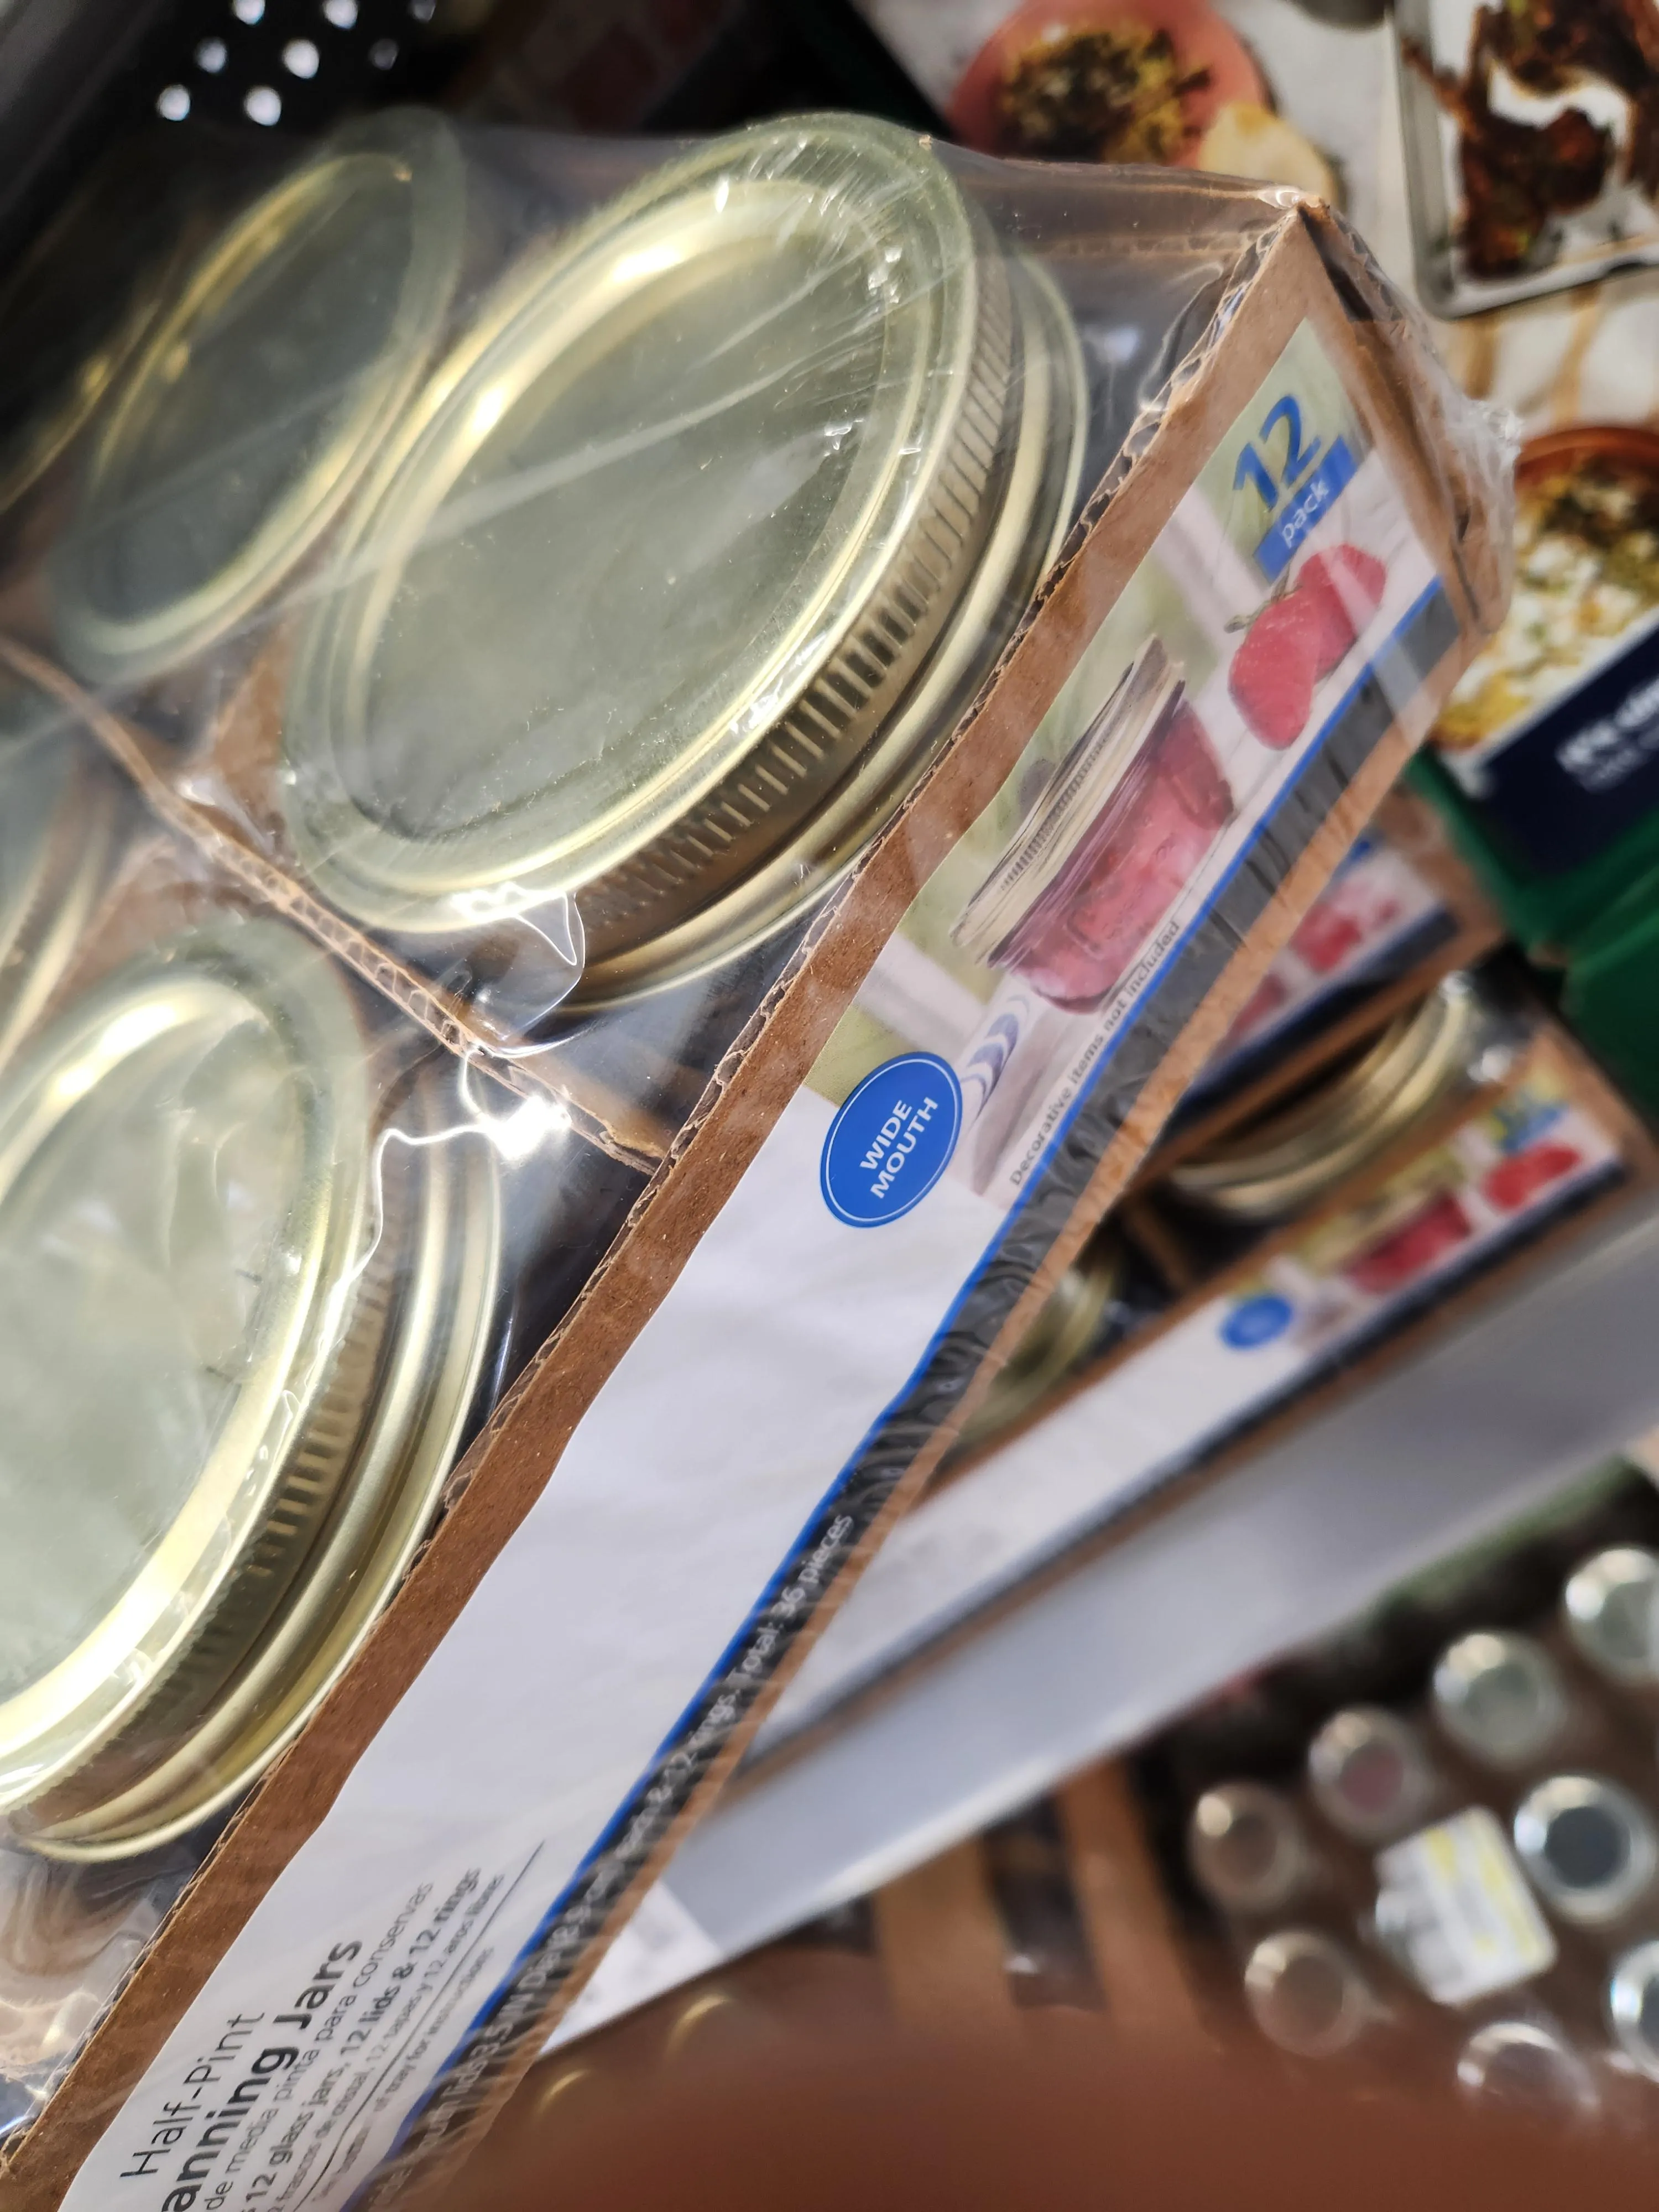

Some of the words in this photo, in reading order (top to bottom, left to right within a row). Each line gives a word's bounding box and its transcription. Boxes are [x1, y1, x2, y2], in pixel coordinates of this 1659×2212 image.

[1233, 394, 1321, 513] 12
[1281, 479, 1329, 549] pack
[1009, 1088, 1072, 1186] Decorative
[1068, 1035, 1105, 1085] items
[1104, 1001, 1126, 1032] not
[1123, 920, 1181, 997] included
[859, 1099, 912, 1170] WIDE
[870, 1097, 938, 1199] MOUTH
[771, 1586, 806, 1619] 36
[798, 1514, 854, 1584] pieces
[245, 2172, 276, 2203] 12
[269, 2110, 315, 2166] glass
[340, 2028, 373, 2056] 12
[358, 1983, 401, 2027] lids
[391, 1964, 414, 1980] &
[409, 1927, 441, 1956] 12
[434, 1867, 481, 1924] rings
[273, 1939, 363, 2031] Jars
[119, 2012, 266, 2178] Half-Pint
[204, 2181, 234, 2211] de
[225, 2108, 278, 2174] media
[273, 2048, 321, 2102] pinta
[314, 1995, 357, 2043] para
[352, 1881, 435, 1989] conservas
